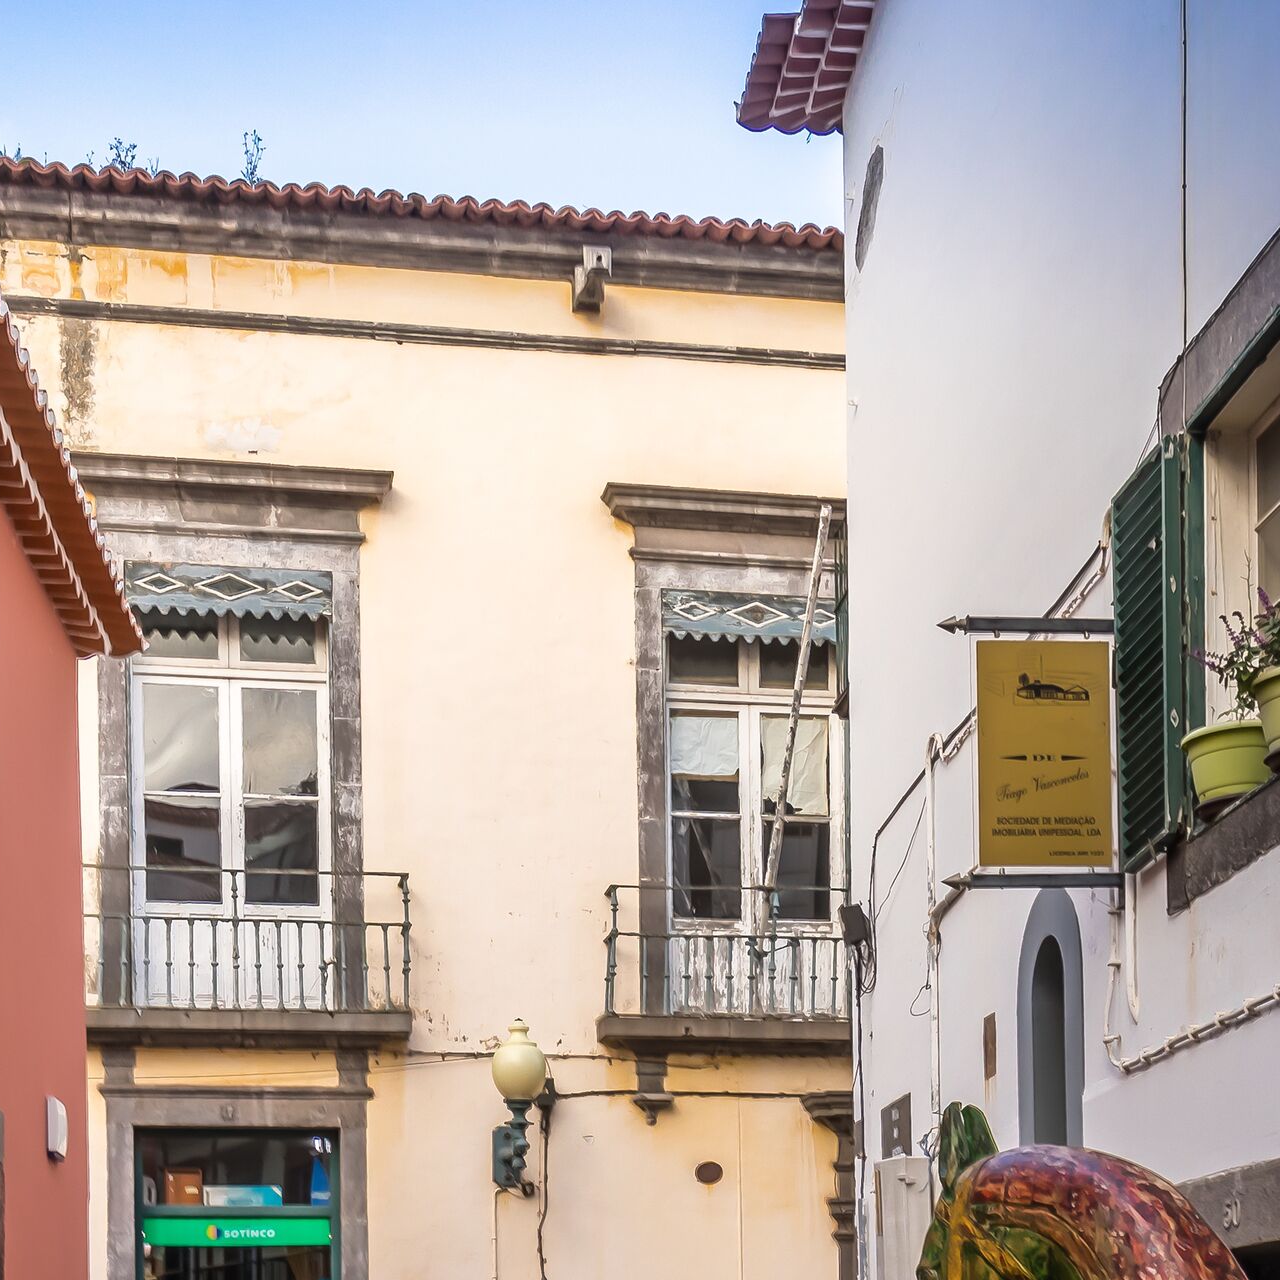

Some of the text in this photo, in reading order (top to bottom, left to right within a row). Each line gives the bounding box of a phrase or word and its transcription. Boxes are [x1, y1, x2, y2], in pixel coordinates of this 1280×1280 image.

[1033, 754, 1056, 762] DE
[996, 767, 1090, 803] Tiago Vasconcelos
[997, 815, 1096, 827] SOCIEDADE DE MEDIAÇÃO
[223, 1229, 276, 1239] SOTINCO
